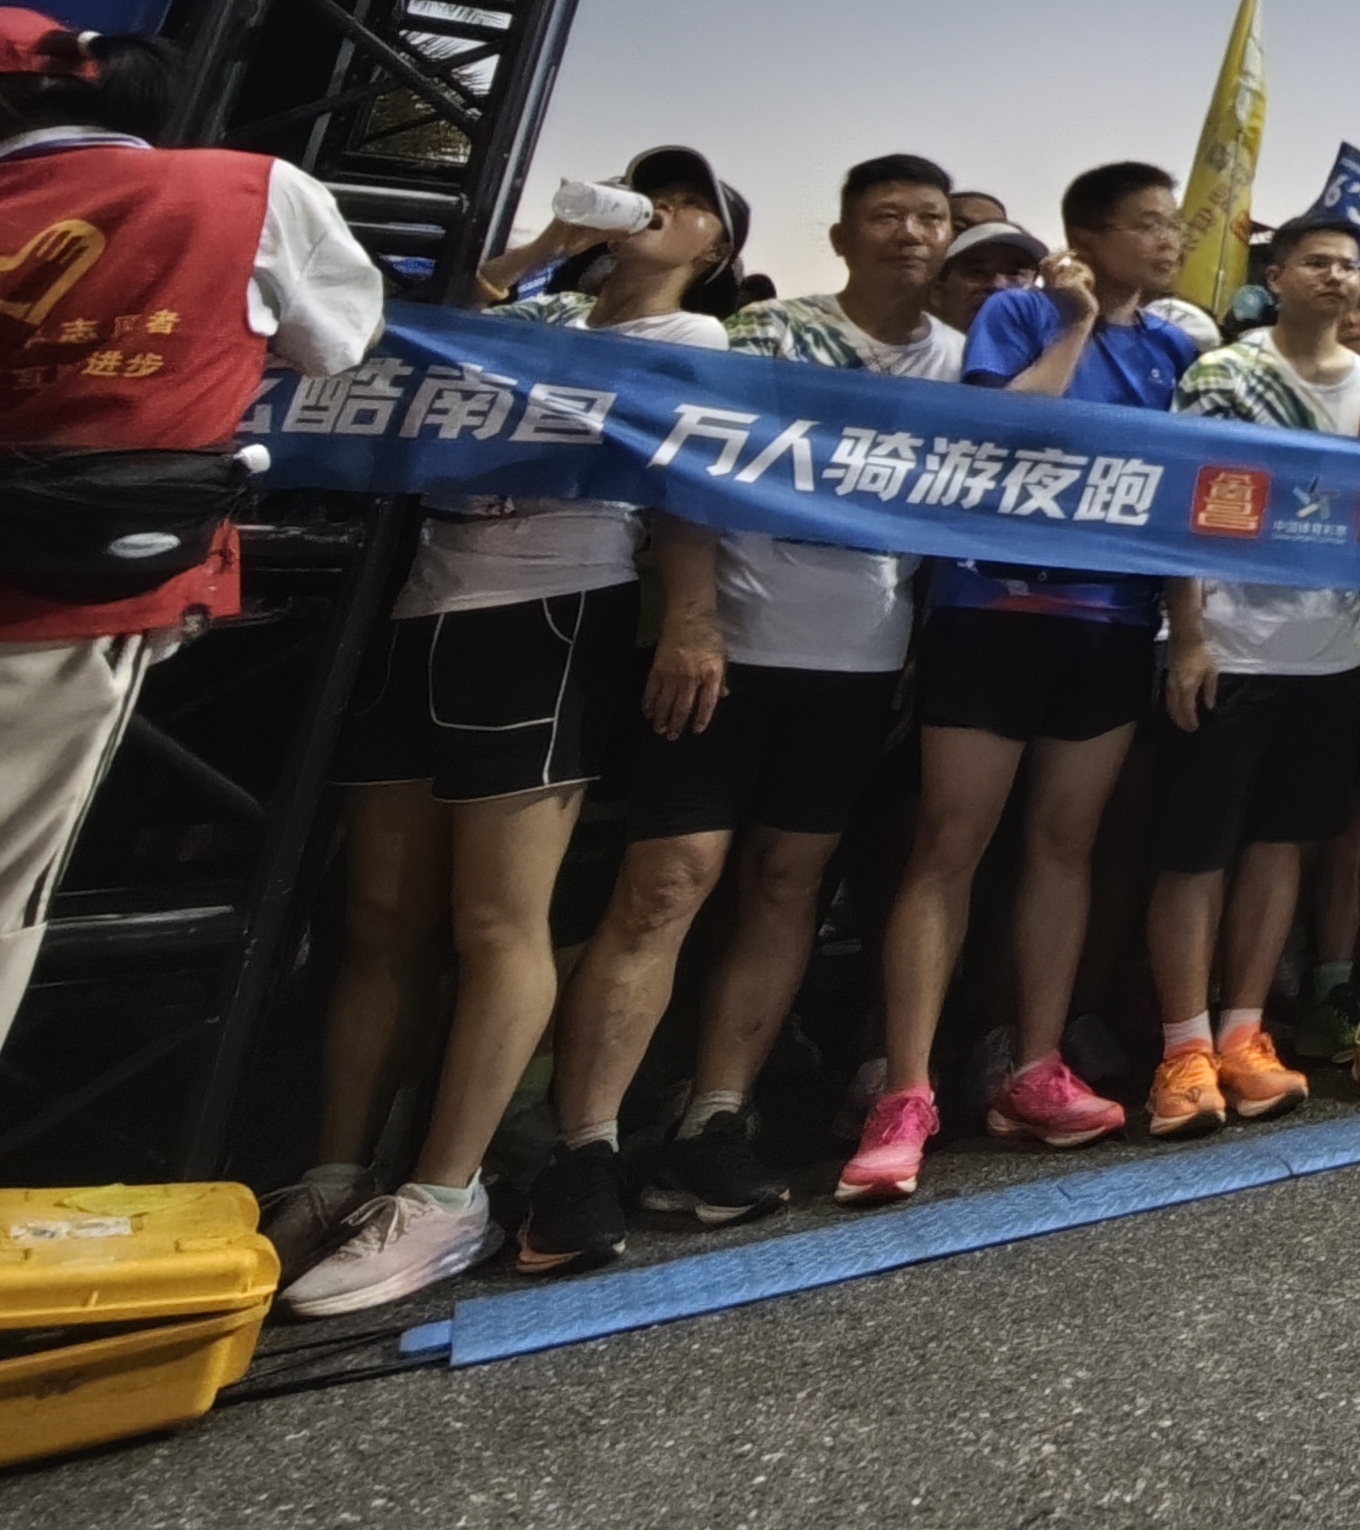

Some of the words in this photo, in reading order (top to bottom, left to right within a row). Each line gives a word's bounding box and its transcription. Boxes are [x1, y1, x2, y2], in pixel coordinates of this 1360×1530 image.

[646, 403, 1165, 526] 万人骑游夜跑
